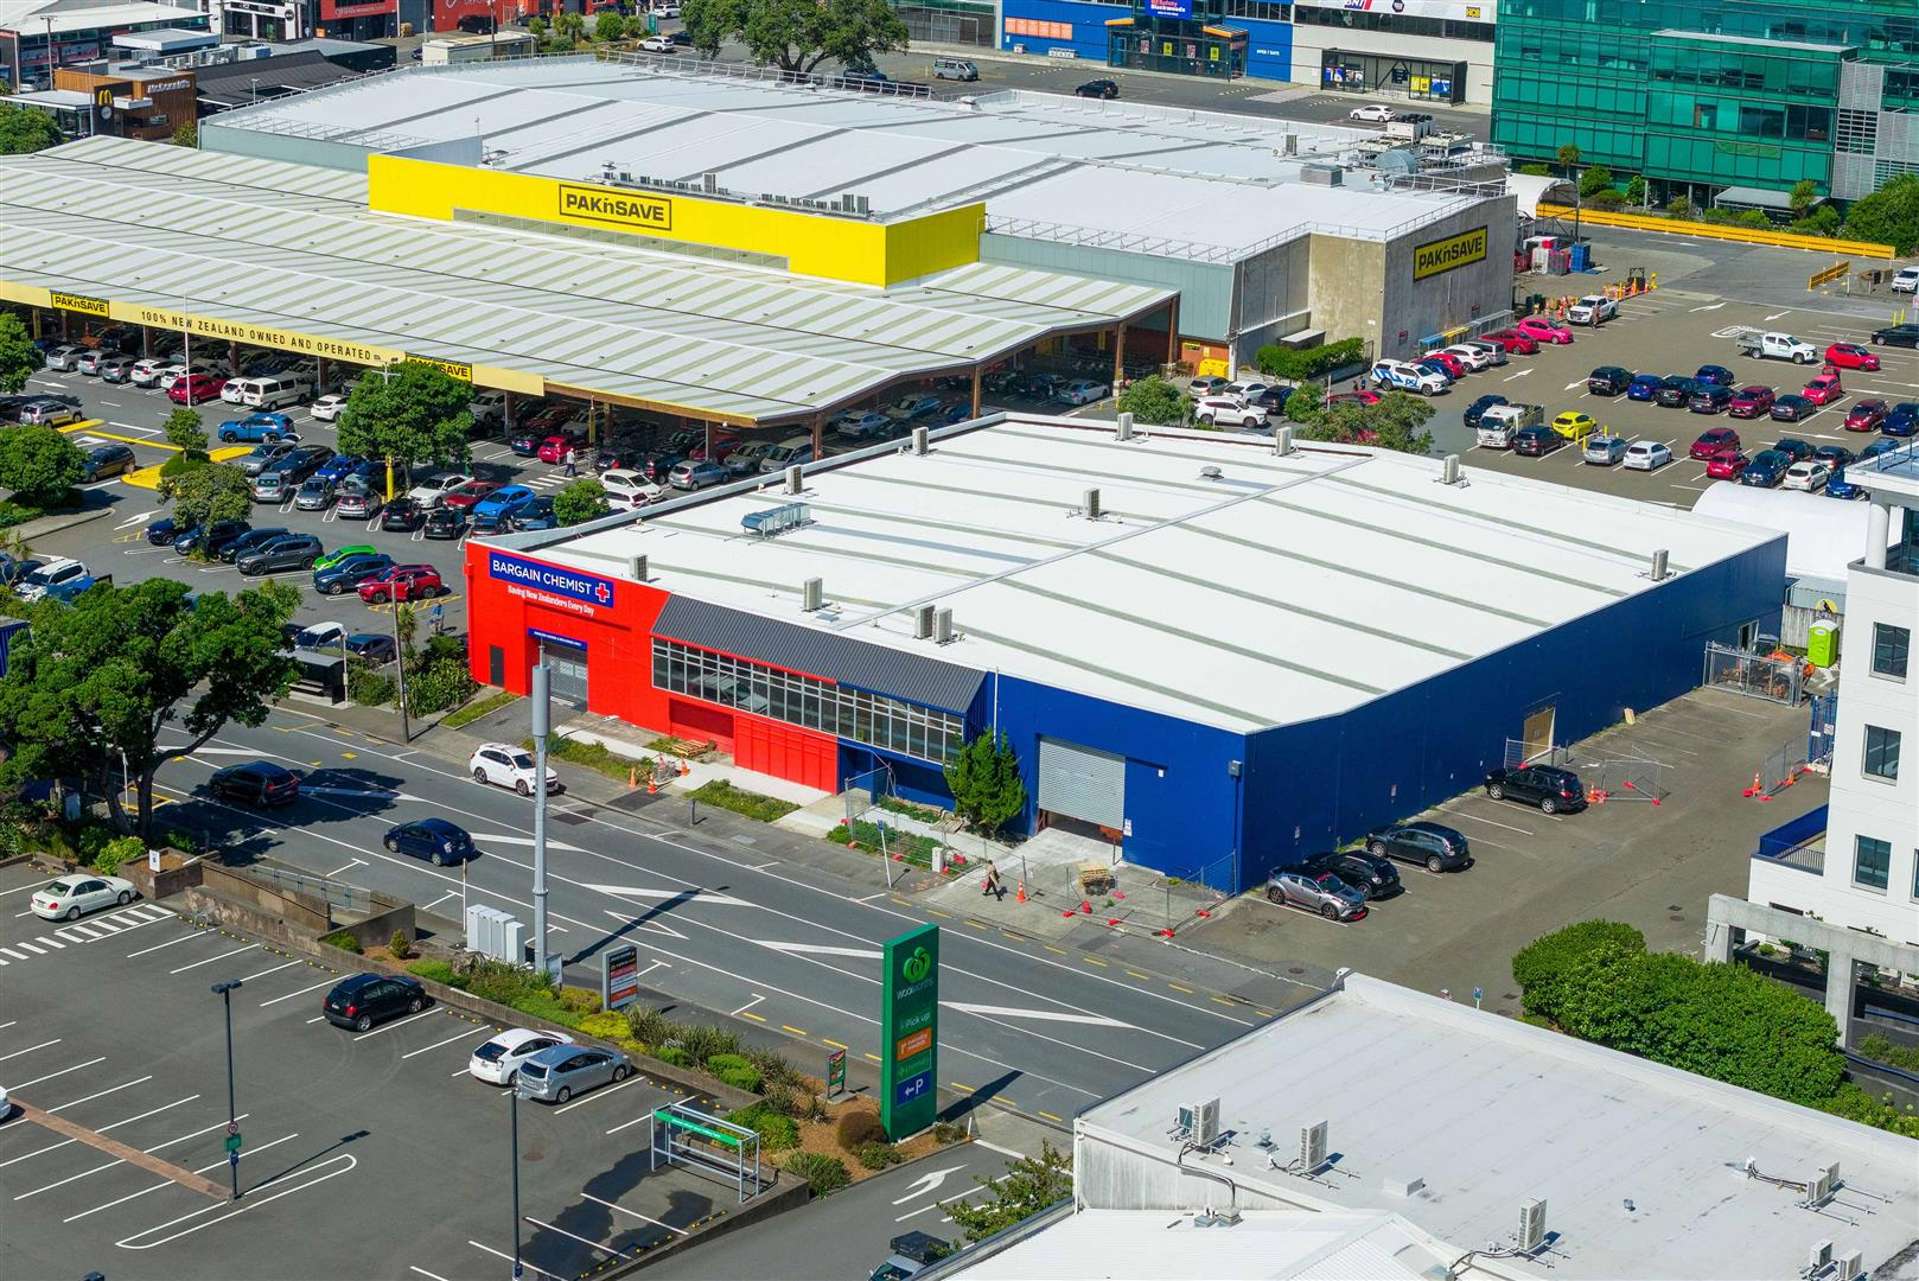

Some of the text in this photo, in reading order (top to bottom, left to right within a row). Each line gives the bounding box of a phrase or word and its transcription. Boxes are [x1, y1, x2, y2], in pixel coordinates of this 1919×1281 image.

[141, 311, 371, 361] 100% NEW ZEALAND OWNED AND OPERATED
[492, 559, 593, 595] BARGAIN CHEMIST
[526, 588, 538, 600] New
[567, 600, 584, 613] Every
[915, 1078, 924, 1095] P
